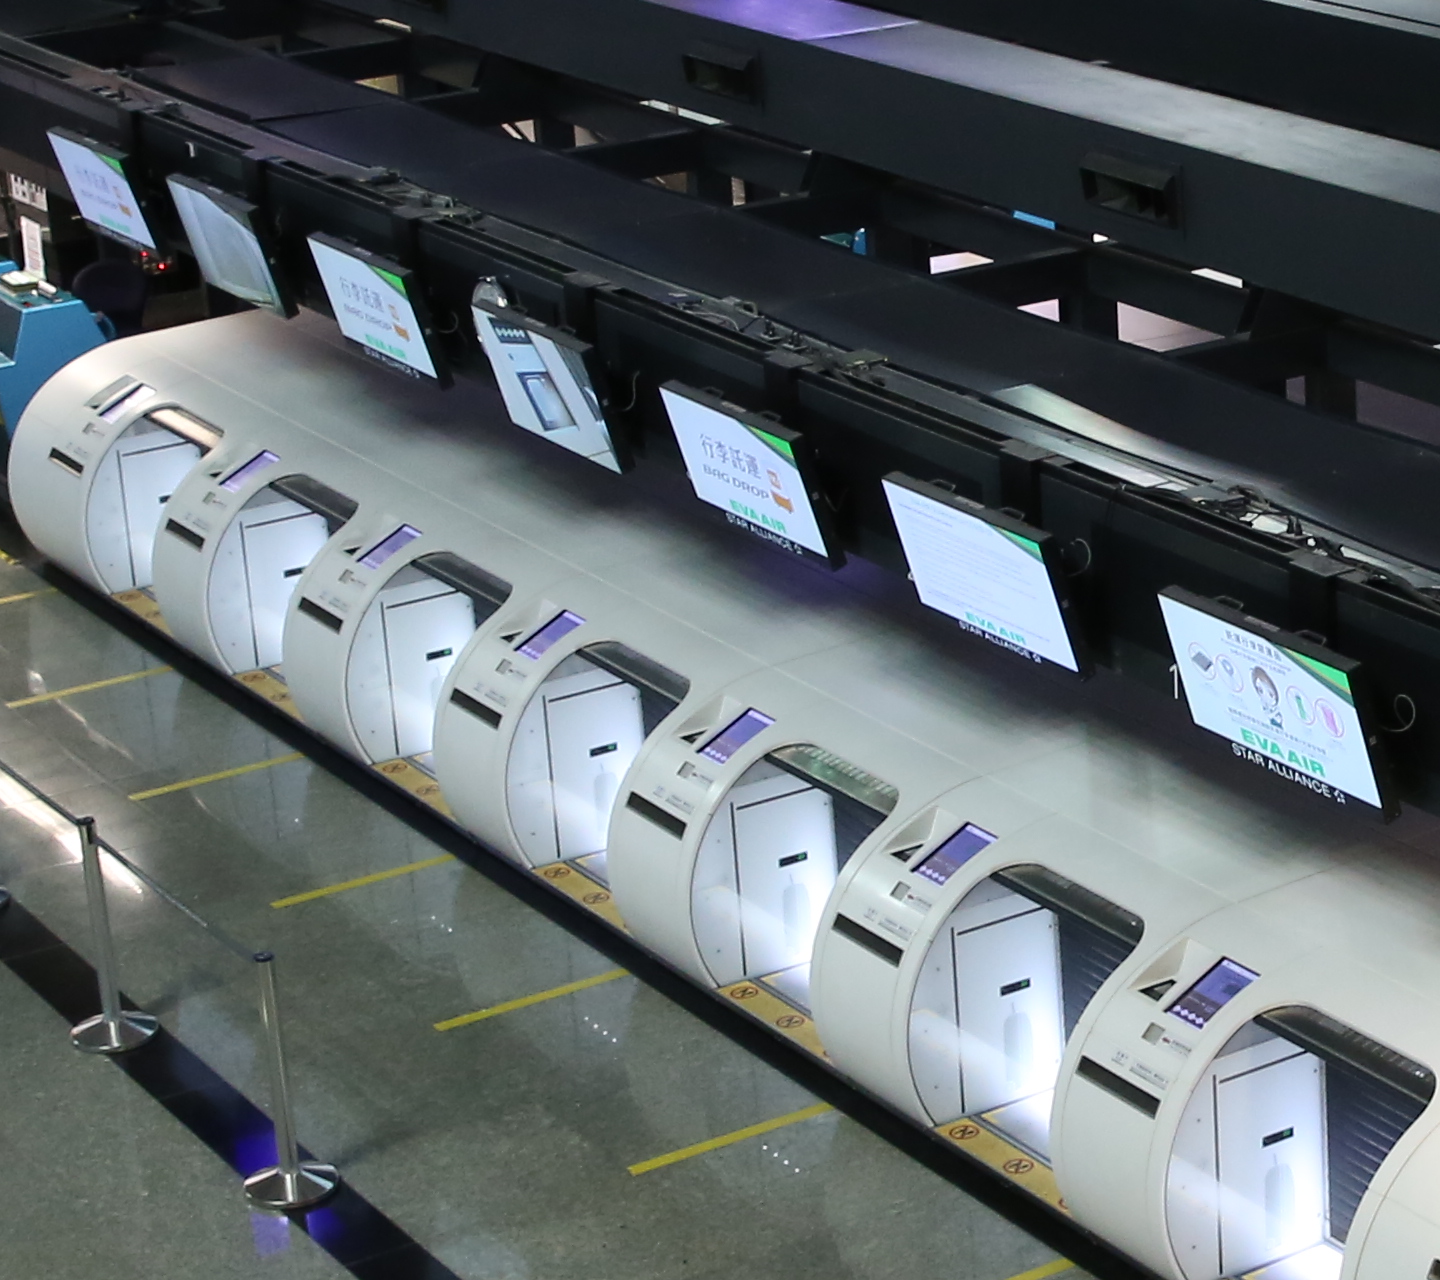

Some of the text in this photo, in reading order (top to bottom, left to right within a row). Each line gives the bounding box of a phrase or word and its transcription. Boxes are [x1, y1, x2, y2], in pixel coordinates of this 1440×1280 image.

[339, 276, 384, 313] 行李託運
[699, 433, 762, 480] 行李託運
[703, 464, 770, 500] BAG DROP
[725, 511, 794, 552] STAR ALLIANCE
[729, 498, 788, 534] EVA AIR
[958, 619, 1031, 660] STAR ALLIANCE
[964, 610, 1027, 646] EVA AIR
[1231, 742, 1333, 799] STAR ALLIANCE
[1240, 727, 1327, 778] EVA AIR
